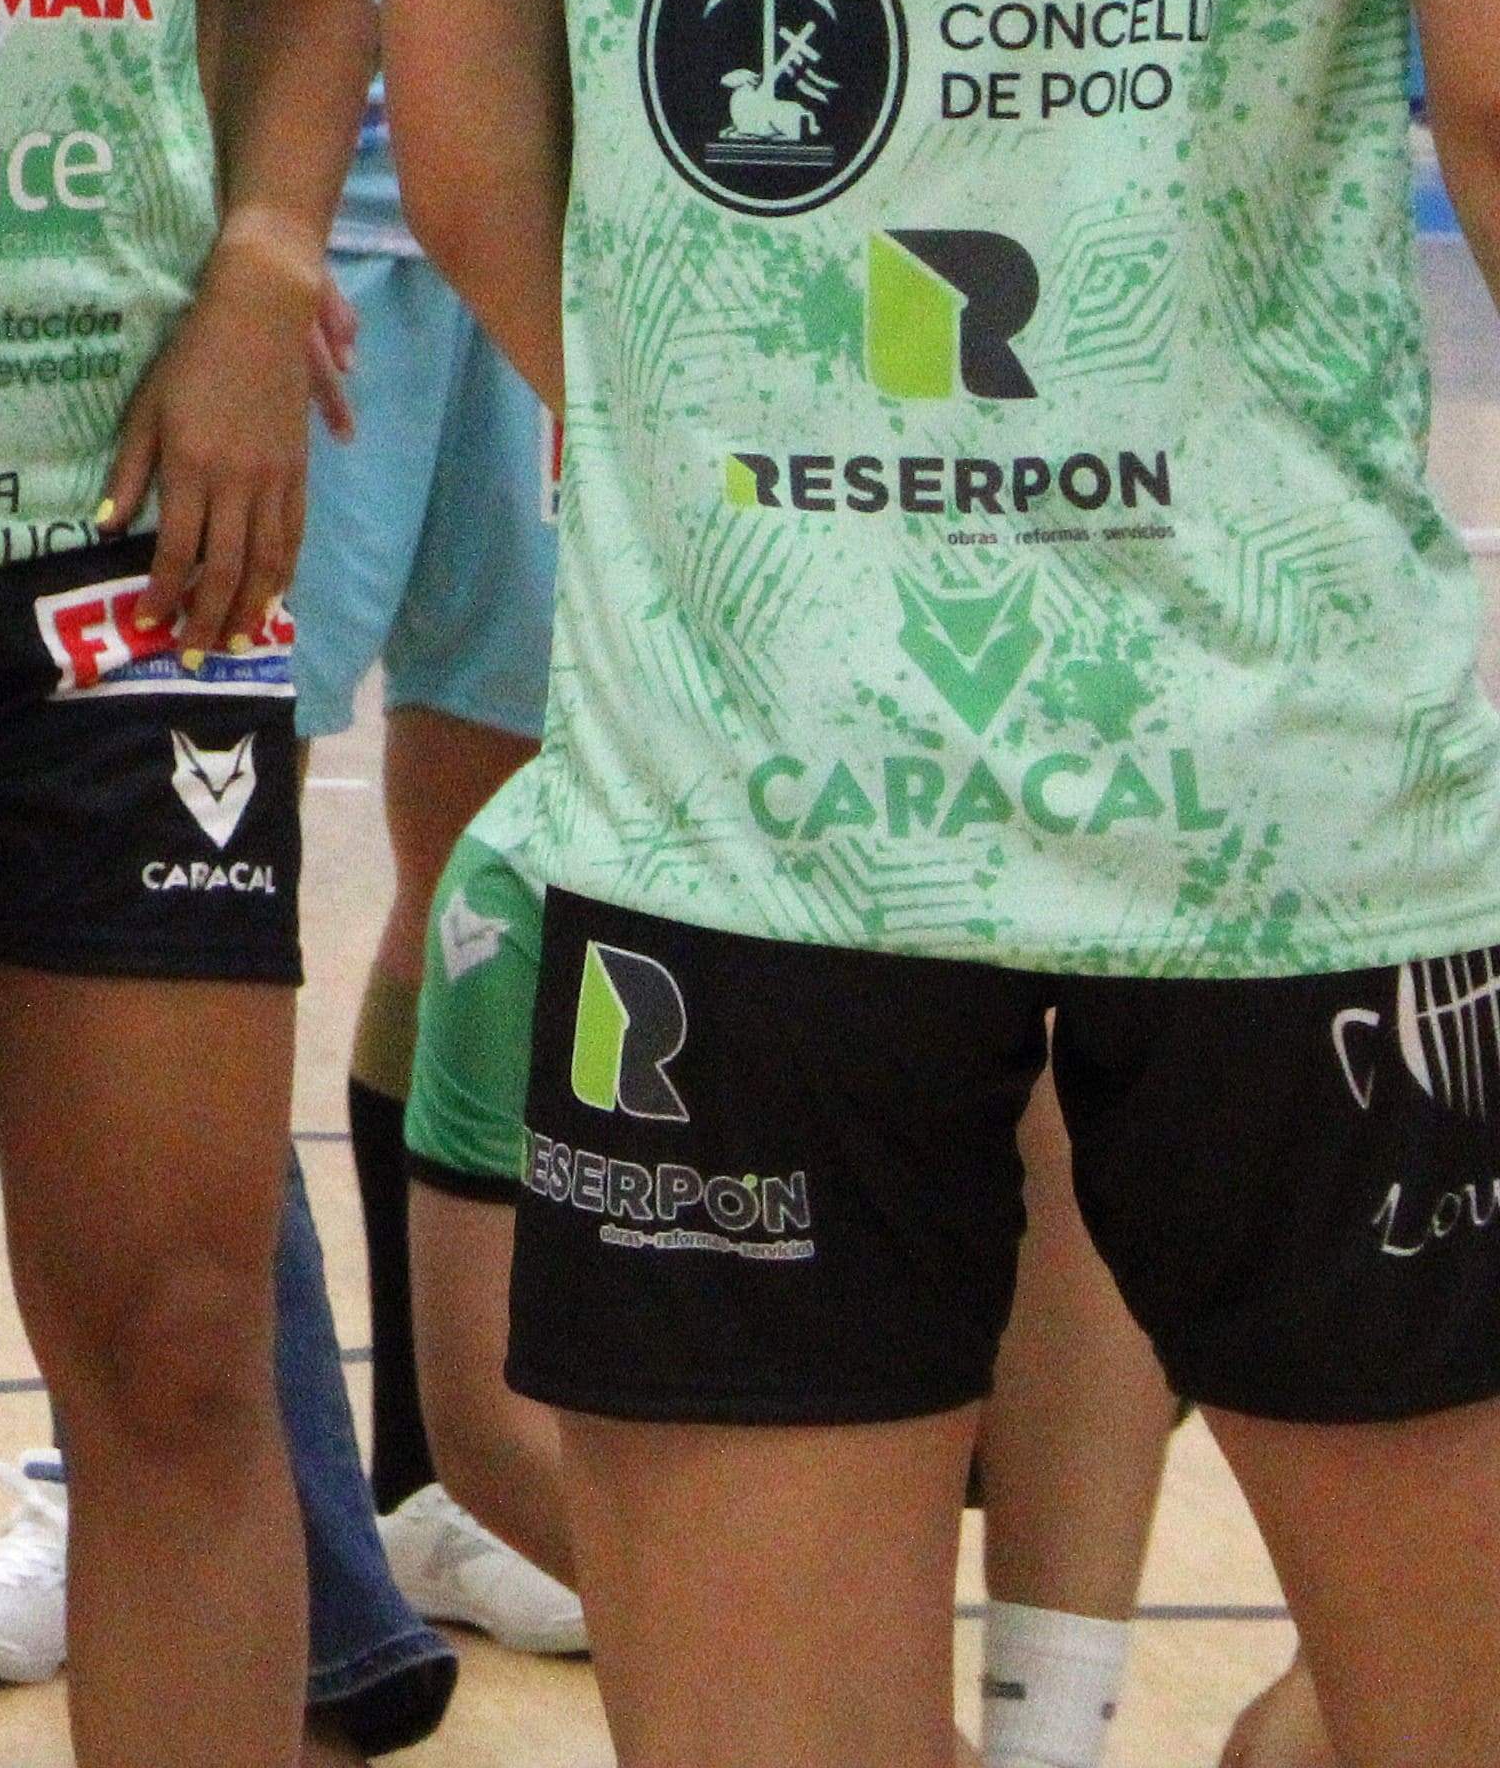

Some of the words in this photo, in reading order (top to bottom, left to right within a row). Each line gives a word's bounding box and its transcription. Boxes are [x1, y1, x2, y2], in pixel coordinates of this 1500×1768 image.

[941, 73, 1020, 120] DE
[1043, 64, 1173, 119] POIO
[725, 449, 1172, 515] RESERPON
[947, 530, 998, 545] obras
[747, 747, 1228, 838] CARACAL
[143, 861, 277, 893] CARACAL
